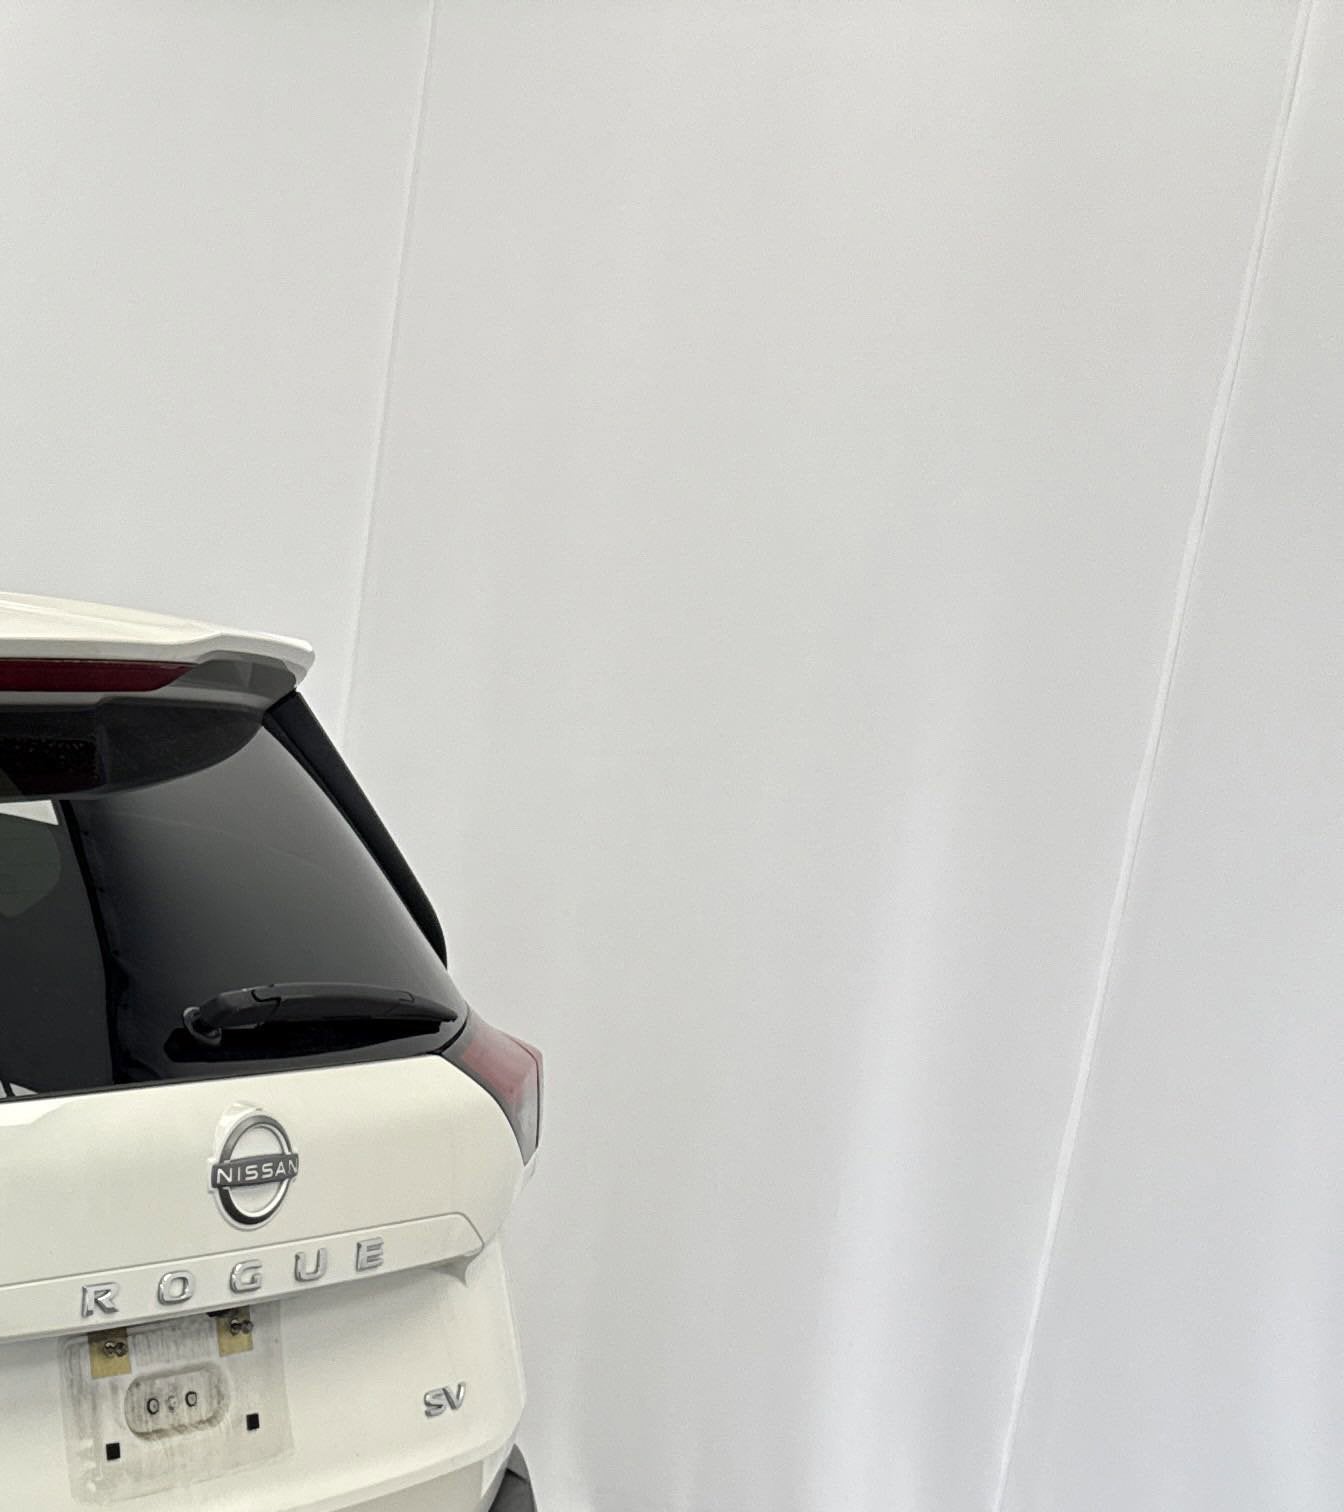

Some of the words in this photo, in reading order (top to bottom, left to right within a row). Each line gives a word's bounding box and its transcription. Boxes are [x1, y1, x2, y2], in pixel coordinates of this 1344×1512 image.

[216, 1159, 298, 1185] NISSAN
[81, 1236, 385, 1318] ROGUE
[424, 1381, 466, 1418] SV
